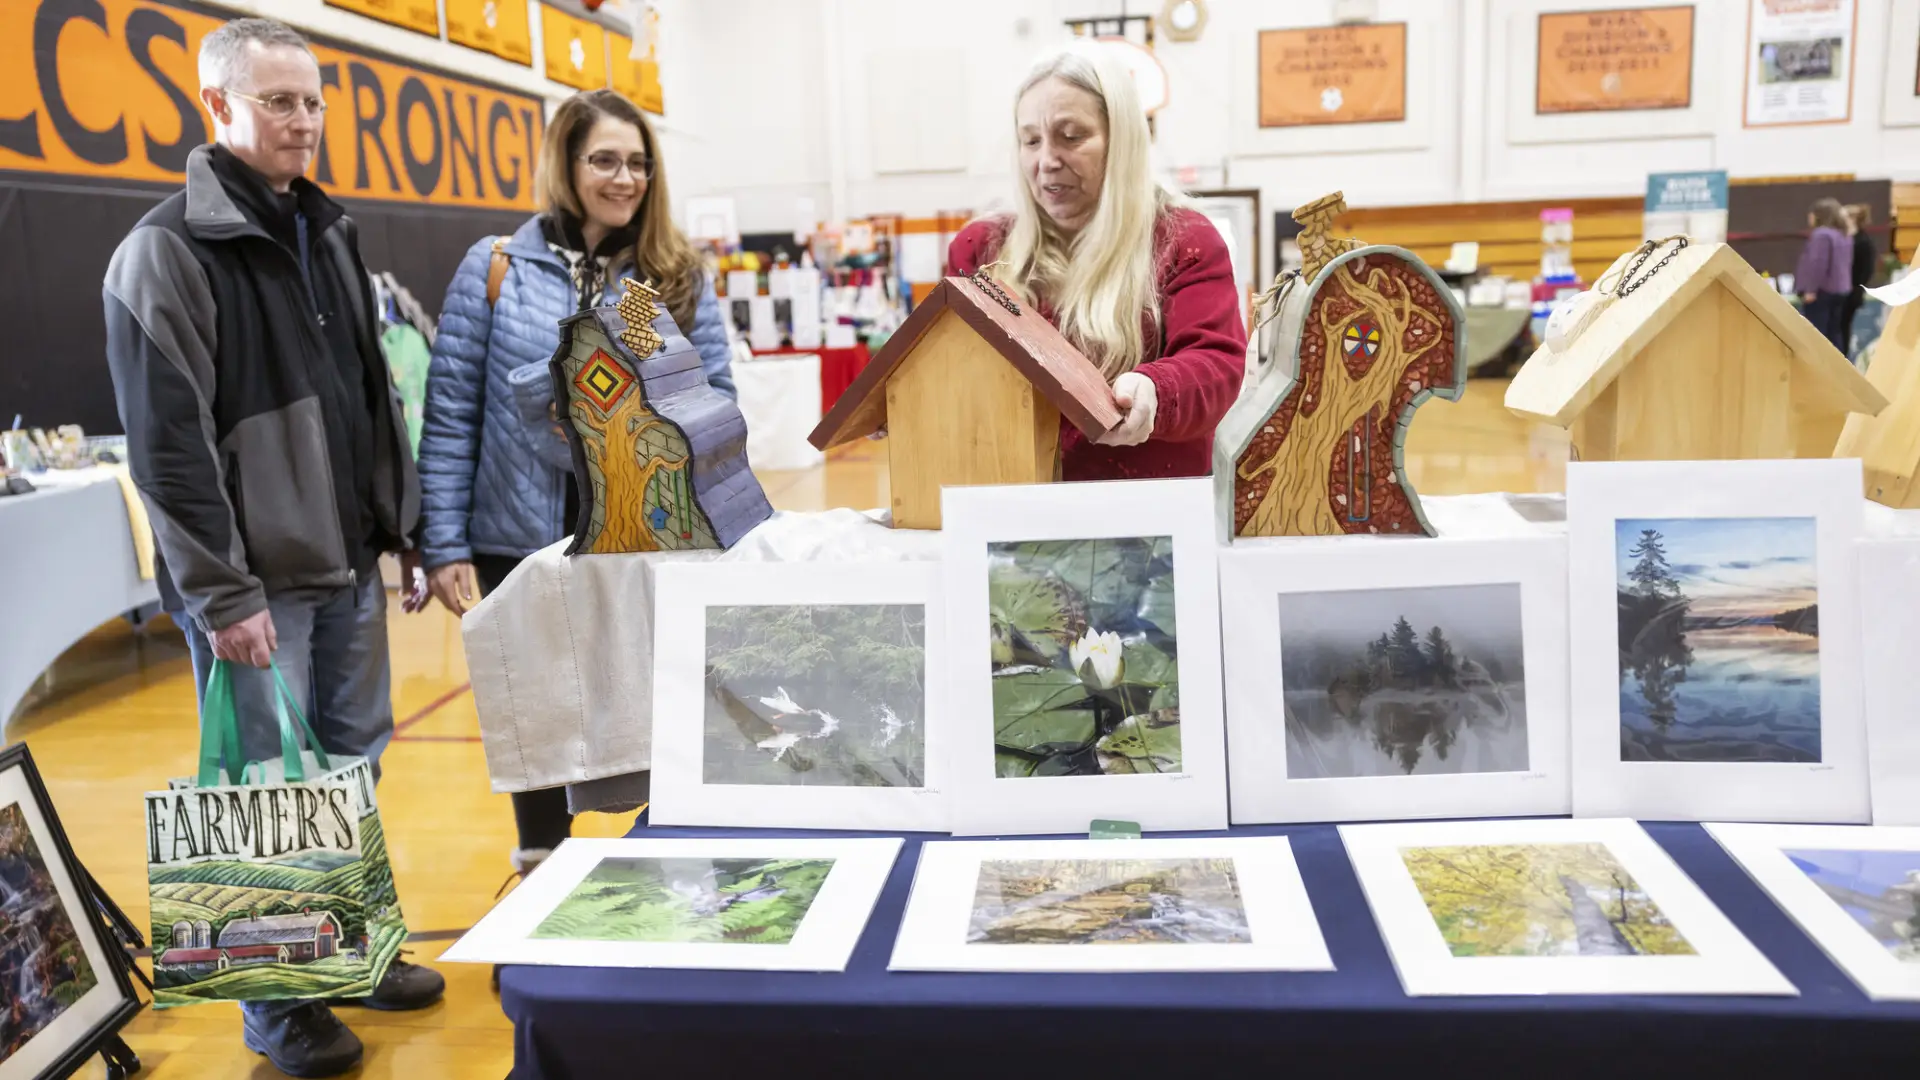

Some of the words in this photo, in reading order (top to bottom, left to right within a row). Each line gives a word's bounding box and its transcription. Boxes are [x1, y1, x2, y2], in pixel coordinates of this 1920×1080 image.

[1275, 58, 1388, 75] CHAMPIONS
[1556, 42, 1672, 58] CHAMPIONS
[316, 61, 534, 200] TRONG!
[146, 787, 354, 864] FARMER'S
